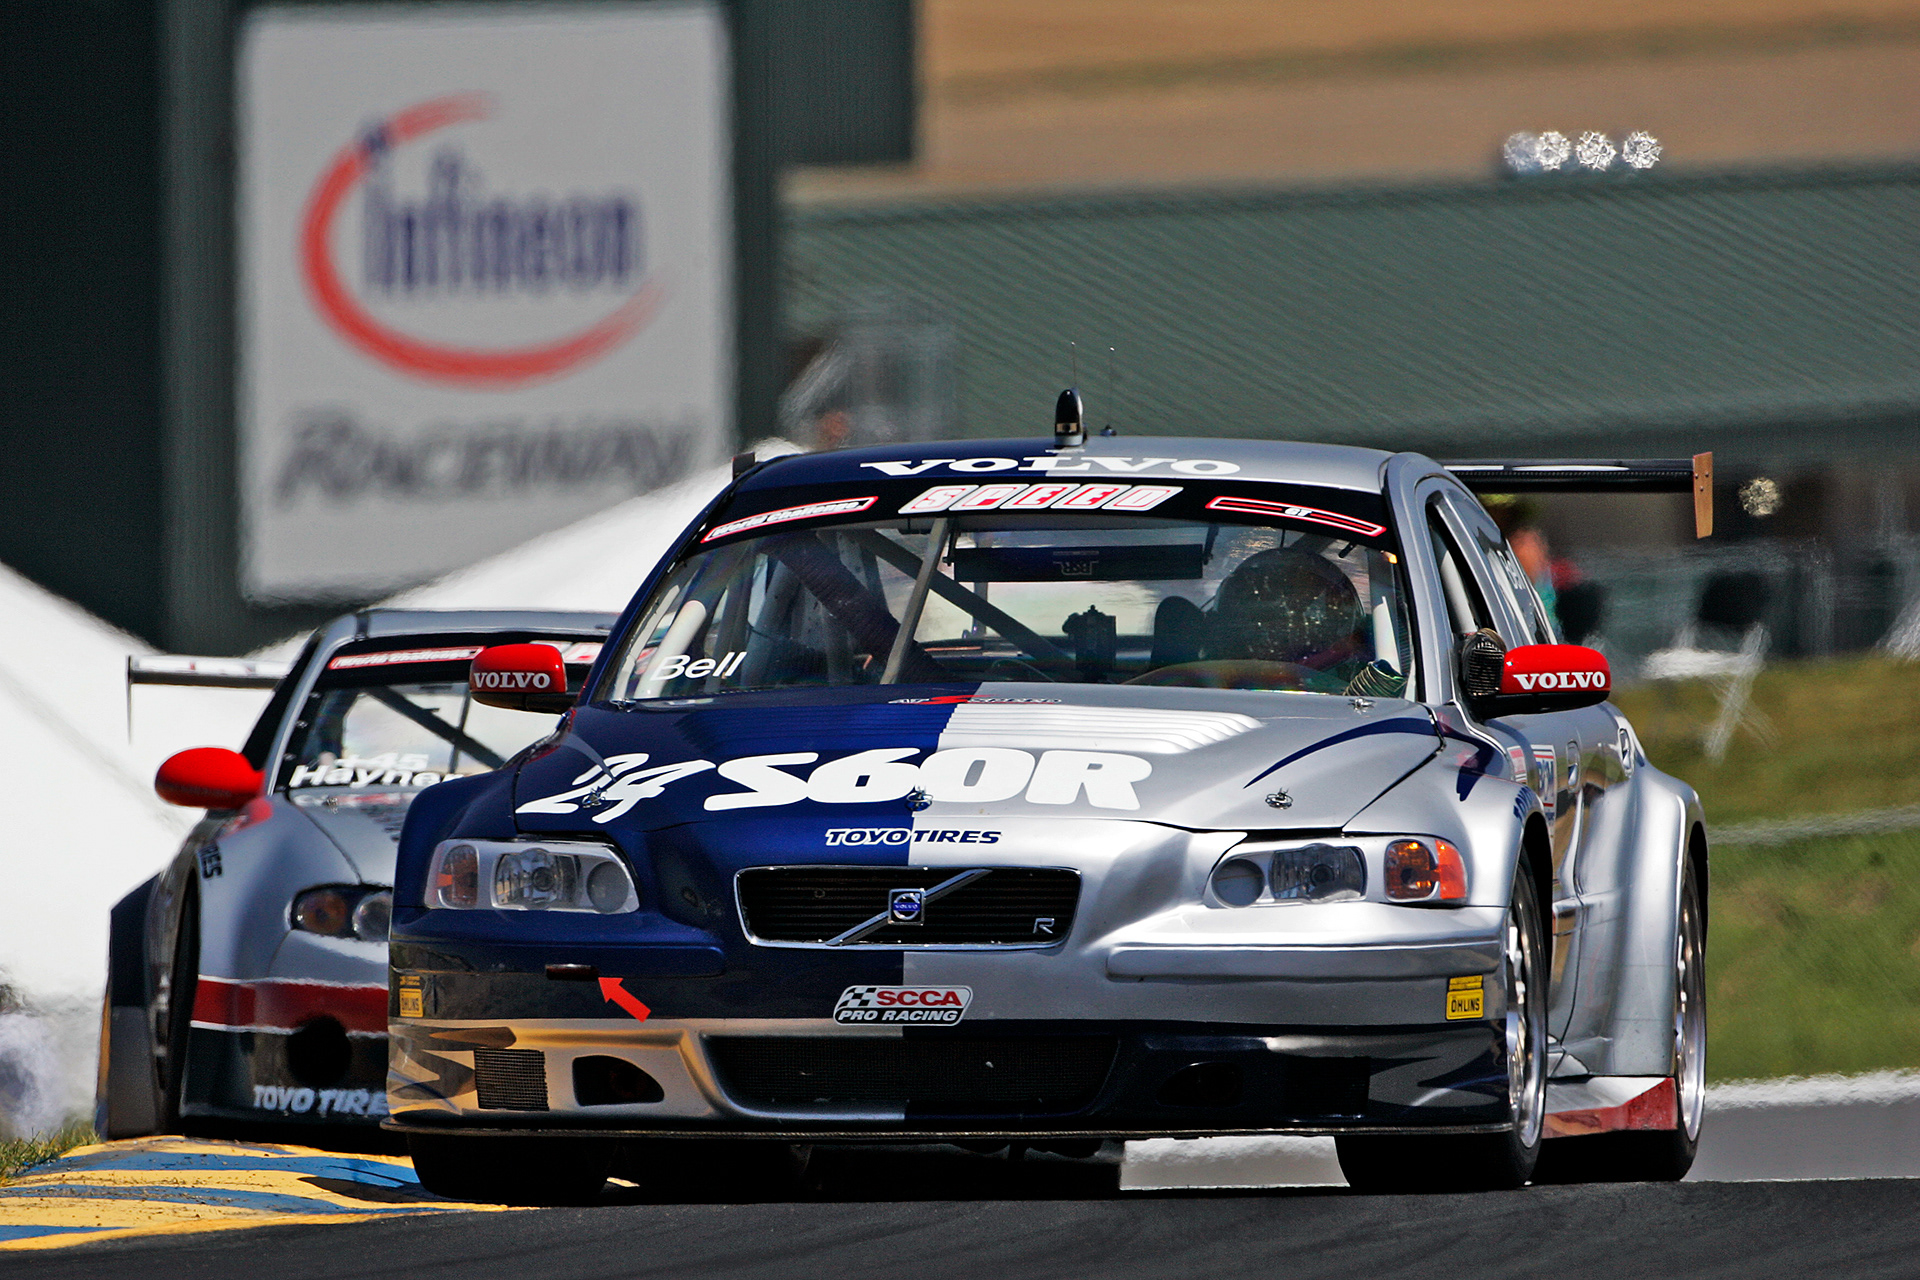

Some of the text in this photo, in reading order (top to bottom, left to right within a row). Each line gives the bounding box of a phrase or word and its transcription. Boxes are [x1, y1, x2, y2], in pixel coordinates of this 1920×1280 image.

[860, 456, 1241, 476] VOLVO
[899, 484, 1183, 513] SPEED
[711, 501, 860, 537] World Challenge
[1284, 506, 1313, 517] GT
[650, 651, 747, 681] Bell
[473, 672, 551, 689] VOLVO
[1512, 671, 1606, 690] VOLVO
[515, 753, 717, 824] 24
[703, 747, 1152, 812] S60R
[825, 828, 1002, 847] TOYO TIRES
[1032, 917, 1055, 934] R
[876, 990, 963, 1007] SCCA
[837, 1010, 959, 1022] PRO RACING
[252, 1084, 390, 1116] TOYO TIRE
